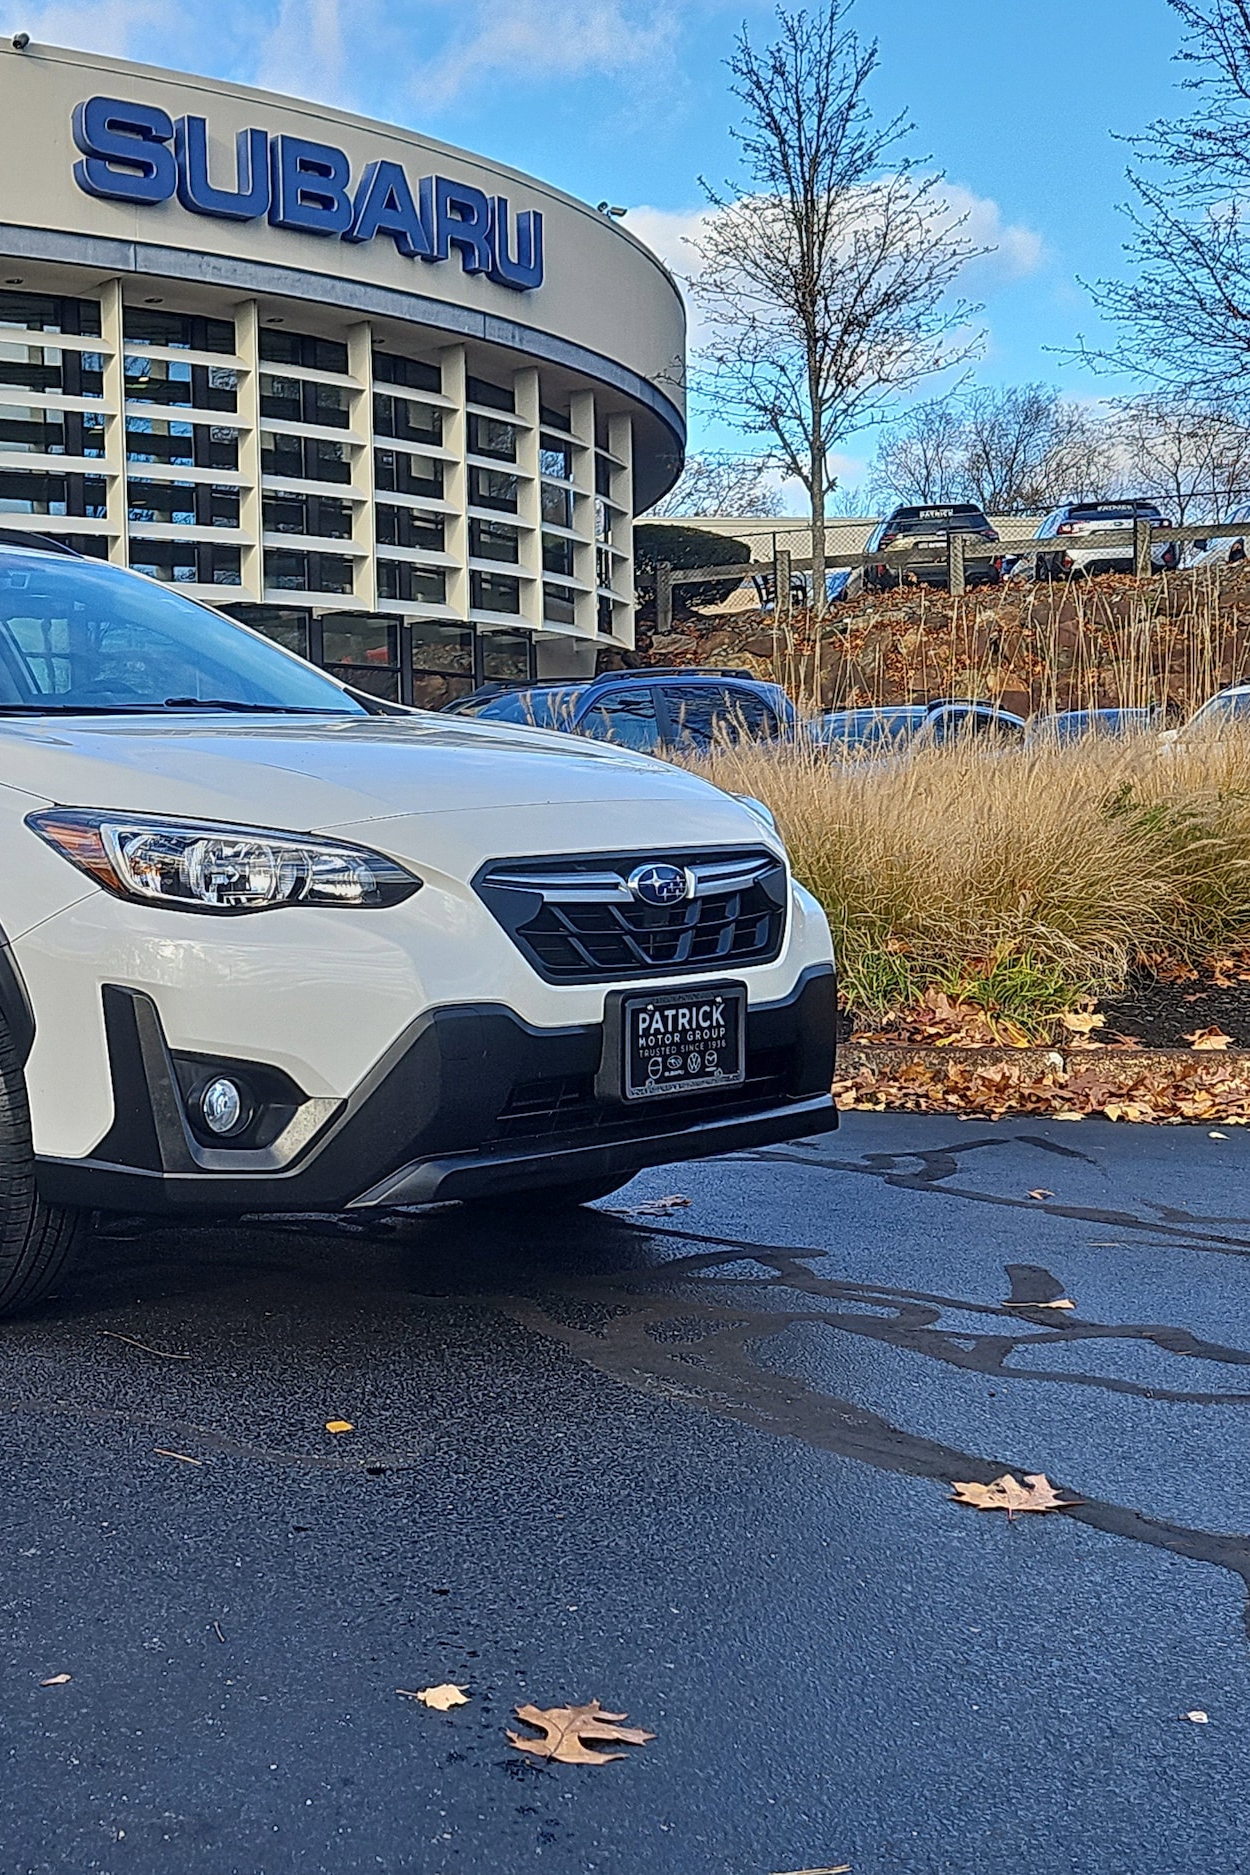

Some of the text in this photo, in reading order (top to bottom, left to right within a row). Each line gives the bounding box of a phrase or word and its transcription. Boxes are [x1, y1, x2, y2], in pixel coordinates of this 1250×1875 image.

[72, 96, 544, 292] SUBARU
[638, 1003, 726, 1036] PATRICK
[638, 1027, 726, 1049] MOTOR GROUP
[639, 1046, 678, 1059] TRUSTED
[680, 1042, 705, 1053] SINCE
